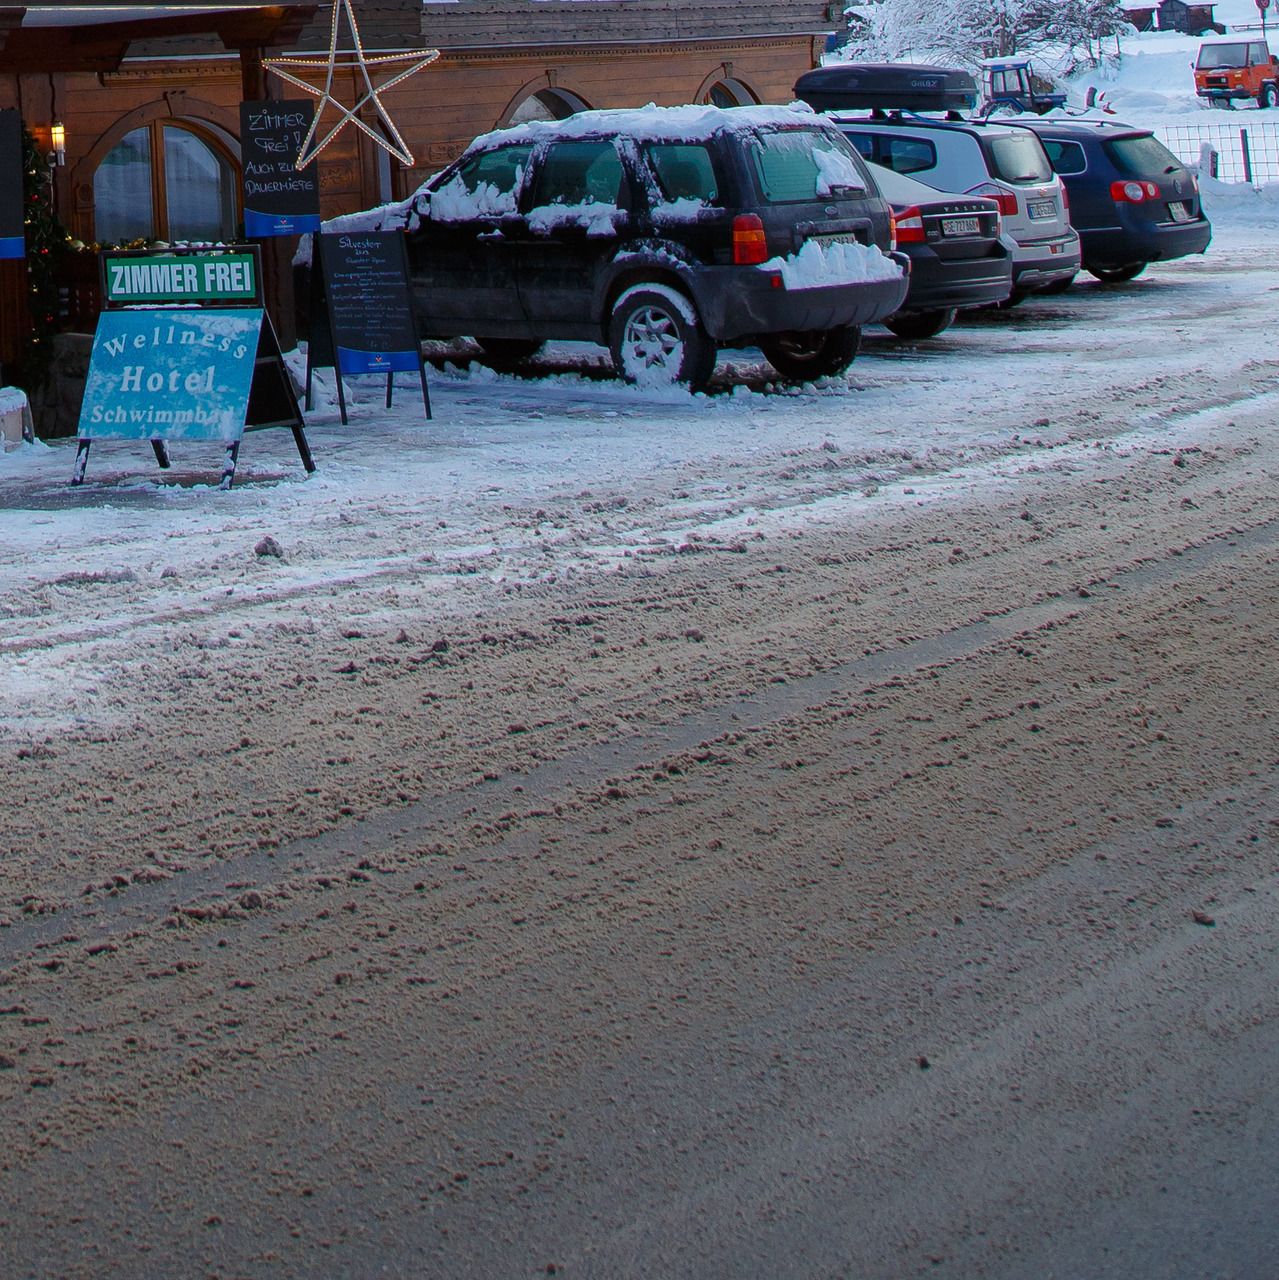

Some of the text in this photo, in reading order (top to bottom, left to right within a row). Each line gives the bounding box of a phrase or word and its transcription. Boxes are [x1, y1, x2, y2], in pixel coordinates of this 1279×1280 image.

[111, 262, 251, 294] ZIMMER FREI
[103, 325, 248, 360] Wellness
[120, 365, 216, 393] Hotel
